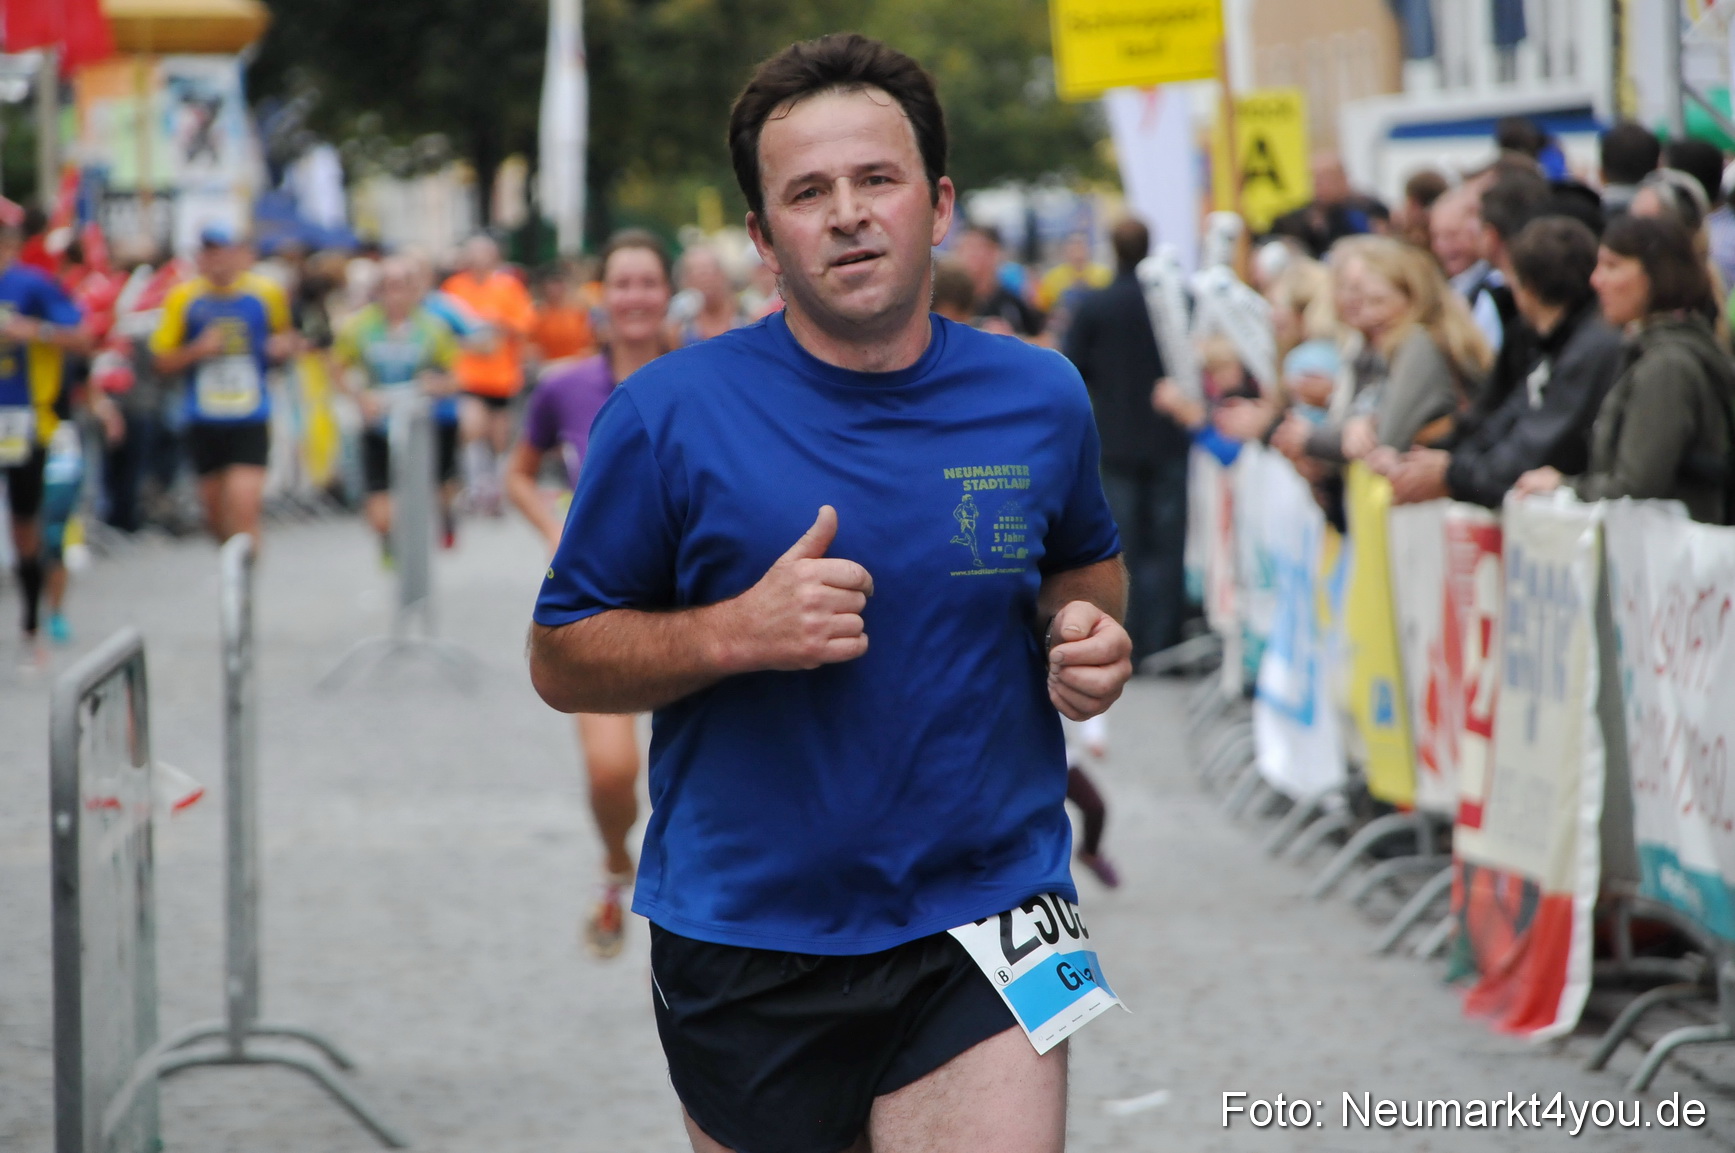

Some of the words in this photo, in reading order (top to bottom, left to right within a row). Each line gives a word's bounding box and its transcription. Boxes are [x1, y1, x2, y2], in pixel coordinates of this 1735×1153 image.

[943, 465, 1030, 479] NEUMARKTER
[963, 478, 1031, 491] STADTLAUF
[994, 532, 1001, 542] 5
[1003, 532, 1026, 543] Jahre
[997, 970, 1010, 984] B
